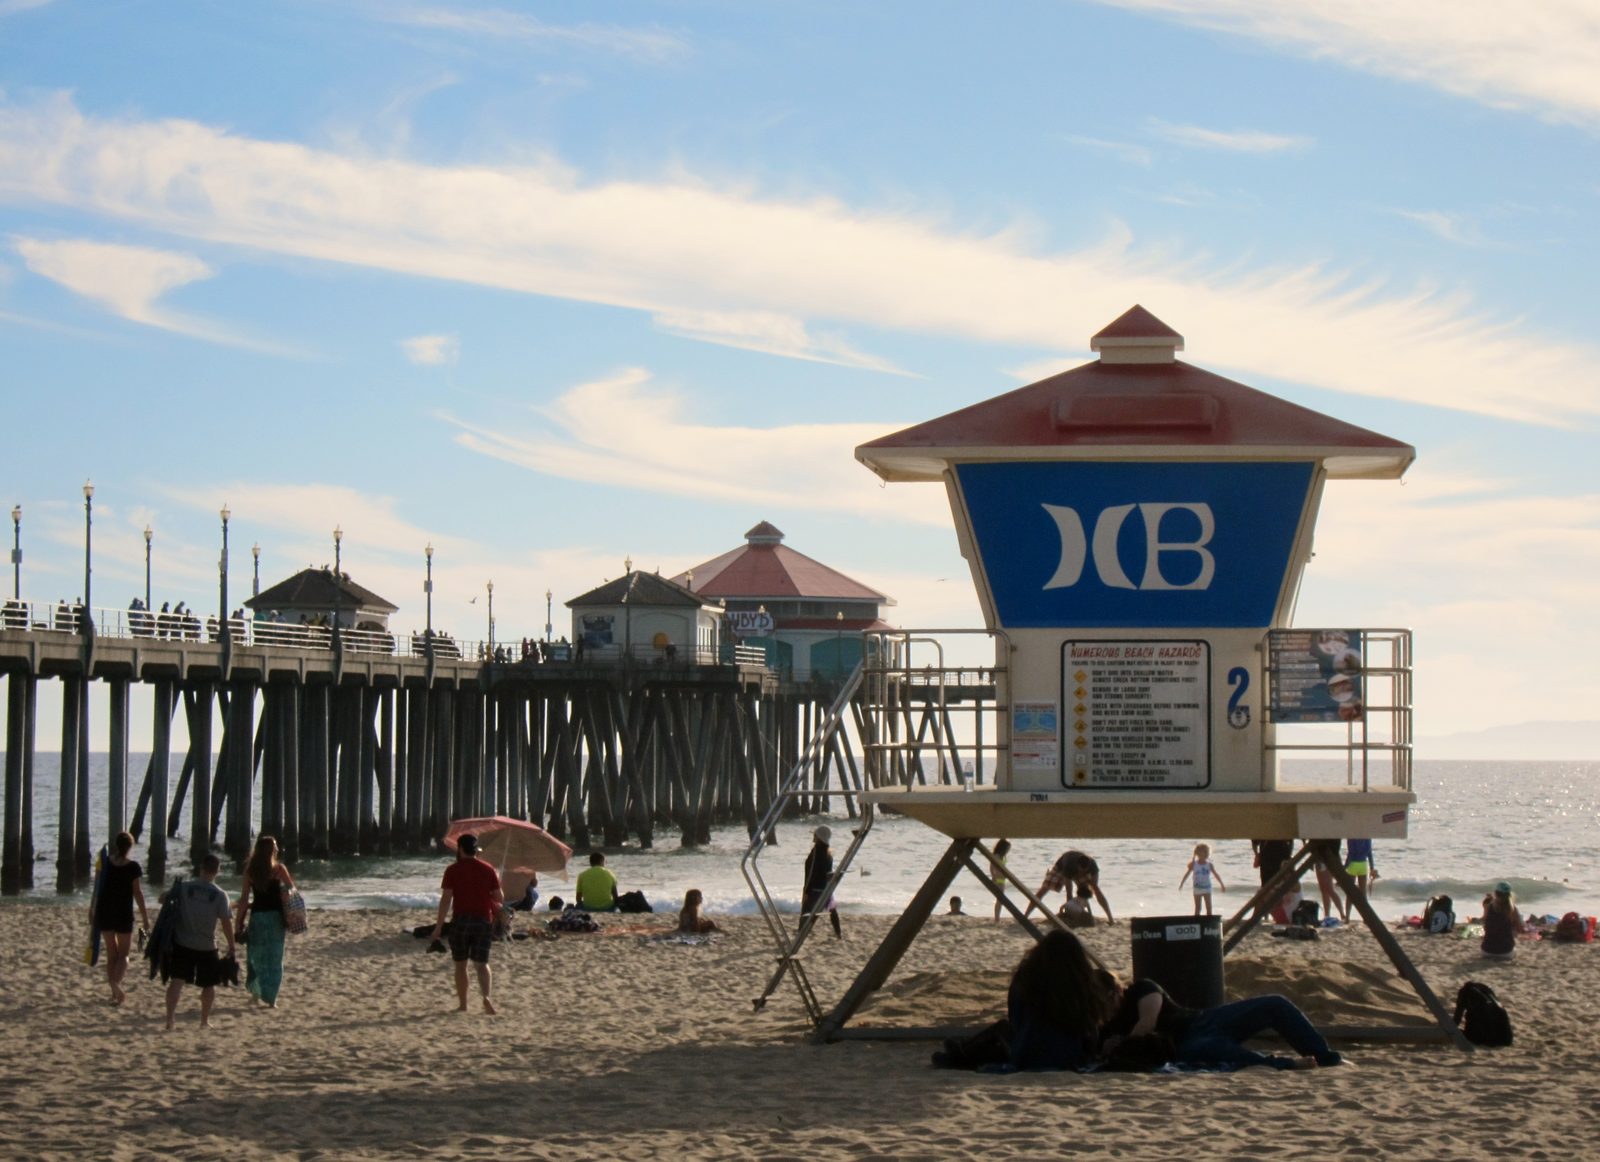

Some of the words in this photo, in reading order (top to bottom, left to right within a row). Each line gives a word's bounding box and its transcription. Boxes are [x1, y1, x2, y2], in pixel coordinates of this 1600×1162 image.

[1070, 647, 1120, 658] NUMEROUS
[1124, 647, 1154, 658] BEACH
[1158, 647, 1202, 658] HAZARDS
[1227, 666, 1250, 717] 2
